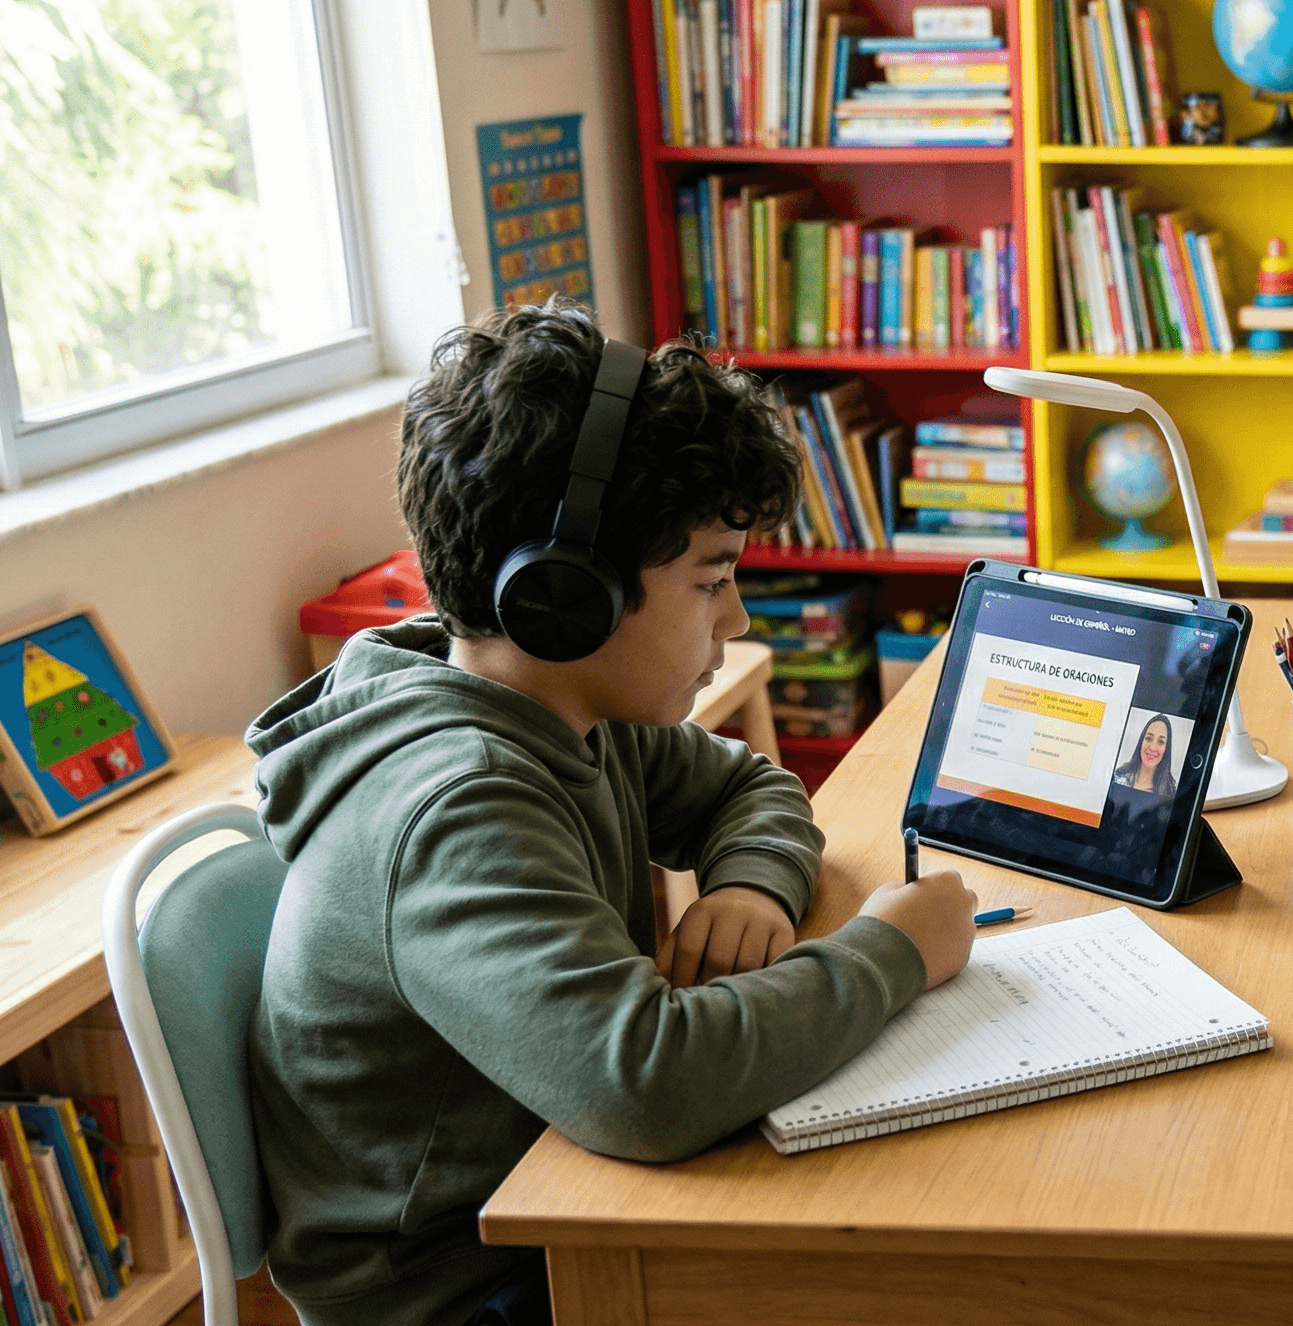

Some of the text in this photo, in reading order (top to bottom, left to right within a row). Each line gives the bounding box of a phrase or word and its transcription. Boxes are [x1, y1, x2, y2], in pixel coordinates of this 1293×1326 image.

[990, 653, 1115, 688] ESTRUCTURA DE ORACIONES
